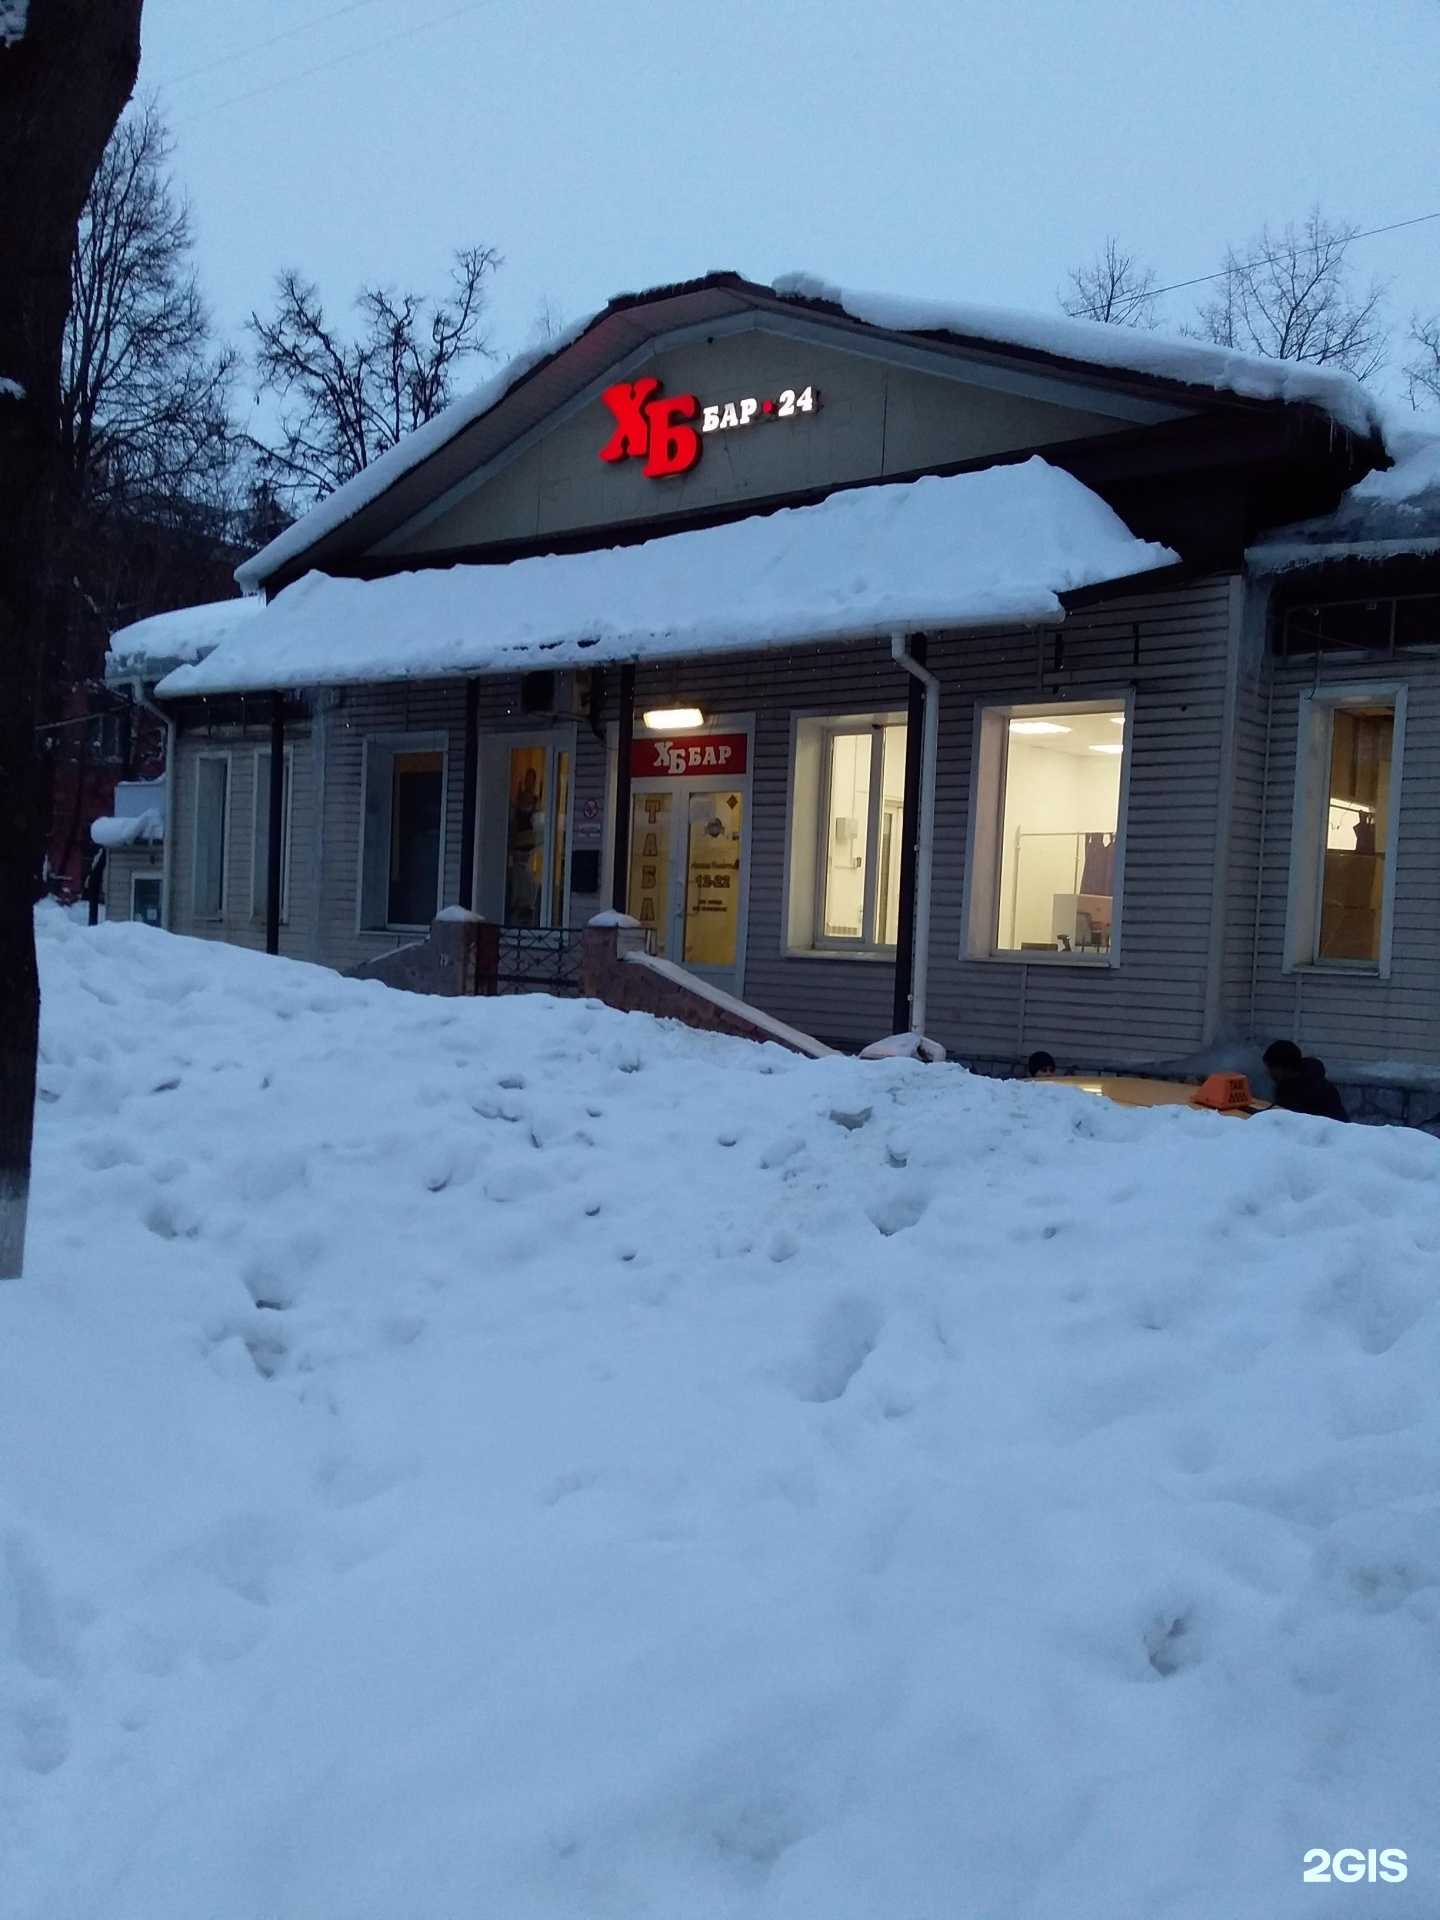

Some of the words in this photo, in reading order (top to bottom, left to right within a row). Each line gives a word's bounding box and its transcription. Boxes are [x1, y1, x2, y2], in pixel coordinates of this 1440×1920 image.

[599, 376, 700, 479] ХБ
[702, 398, 757, 432] БАР
[778, 386, 814, 417] 24
[653, 741, 686, 774] ХБ
[688, 745, 732, 766] БАР
